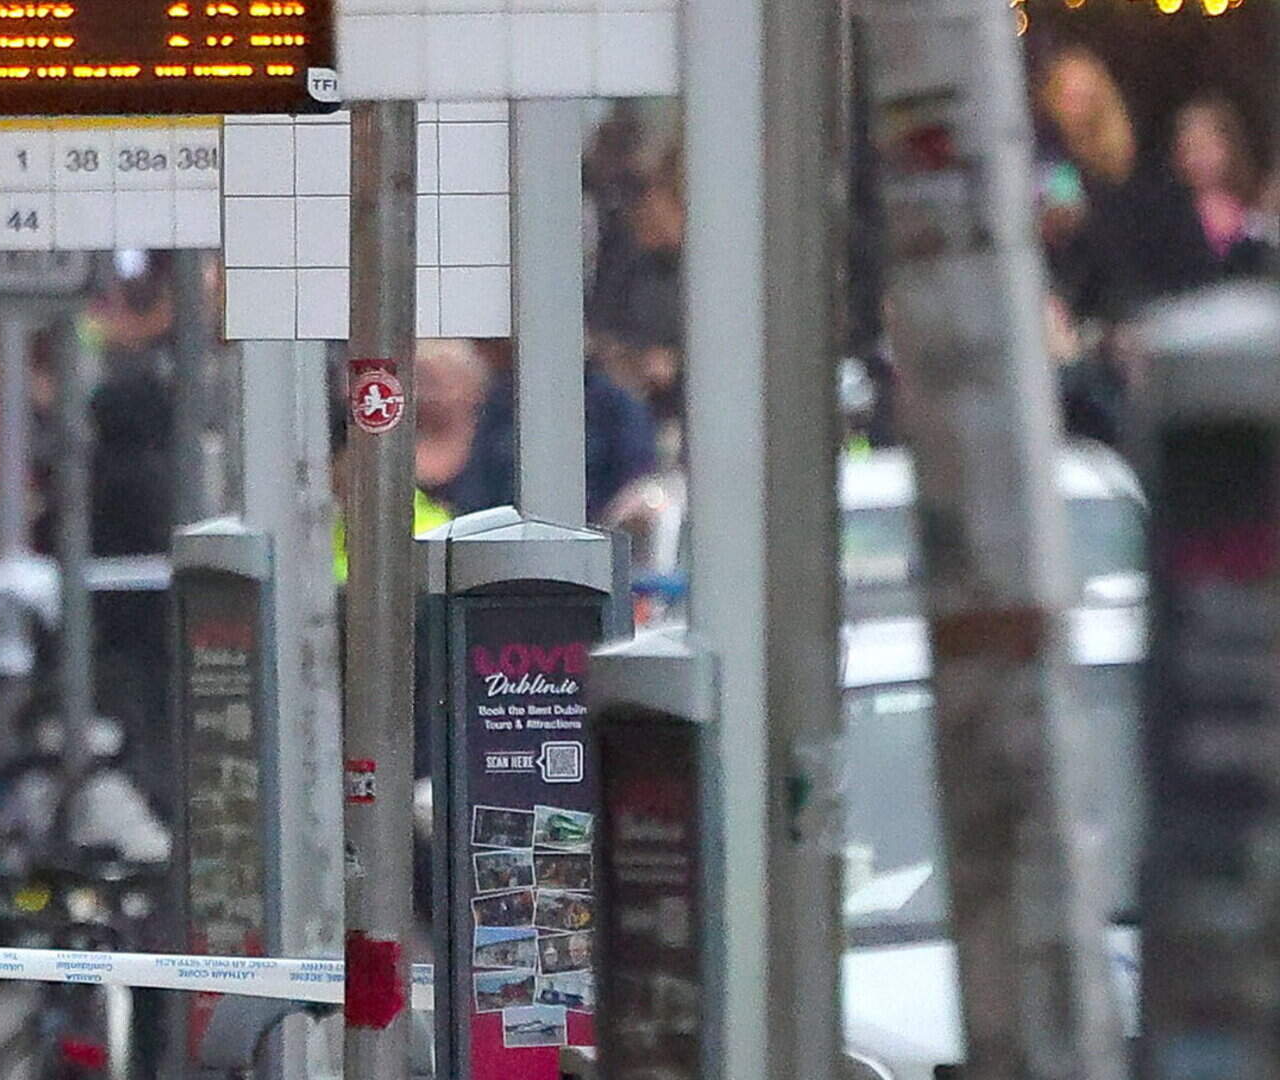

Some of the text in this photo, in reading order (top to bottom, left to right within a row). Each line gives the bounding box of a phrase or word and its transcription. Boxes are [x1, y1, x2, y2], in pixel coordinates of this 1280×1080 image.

[312, 79, 338, 92] TFI
[16, 150, 28, 171] 1
[66, 149, 99, 172] 38
[117, 148, 168, 172] 38a
[7, 210, 40, 232] 44
[472, 642, 586, 675] LOVE
[484, 671, 580, 697] Dublin.ie
[478, 704, 588, 717] Book the Best Dublin
[485, 719, 582, 731] Tours & Attractions
[485, 755, 535, 769] SCAN HERE
